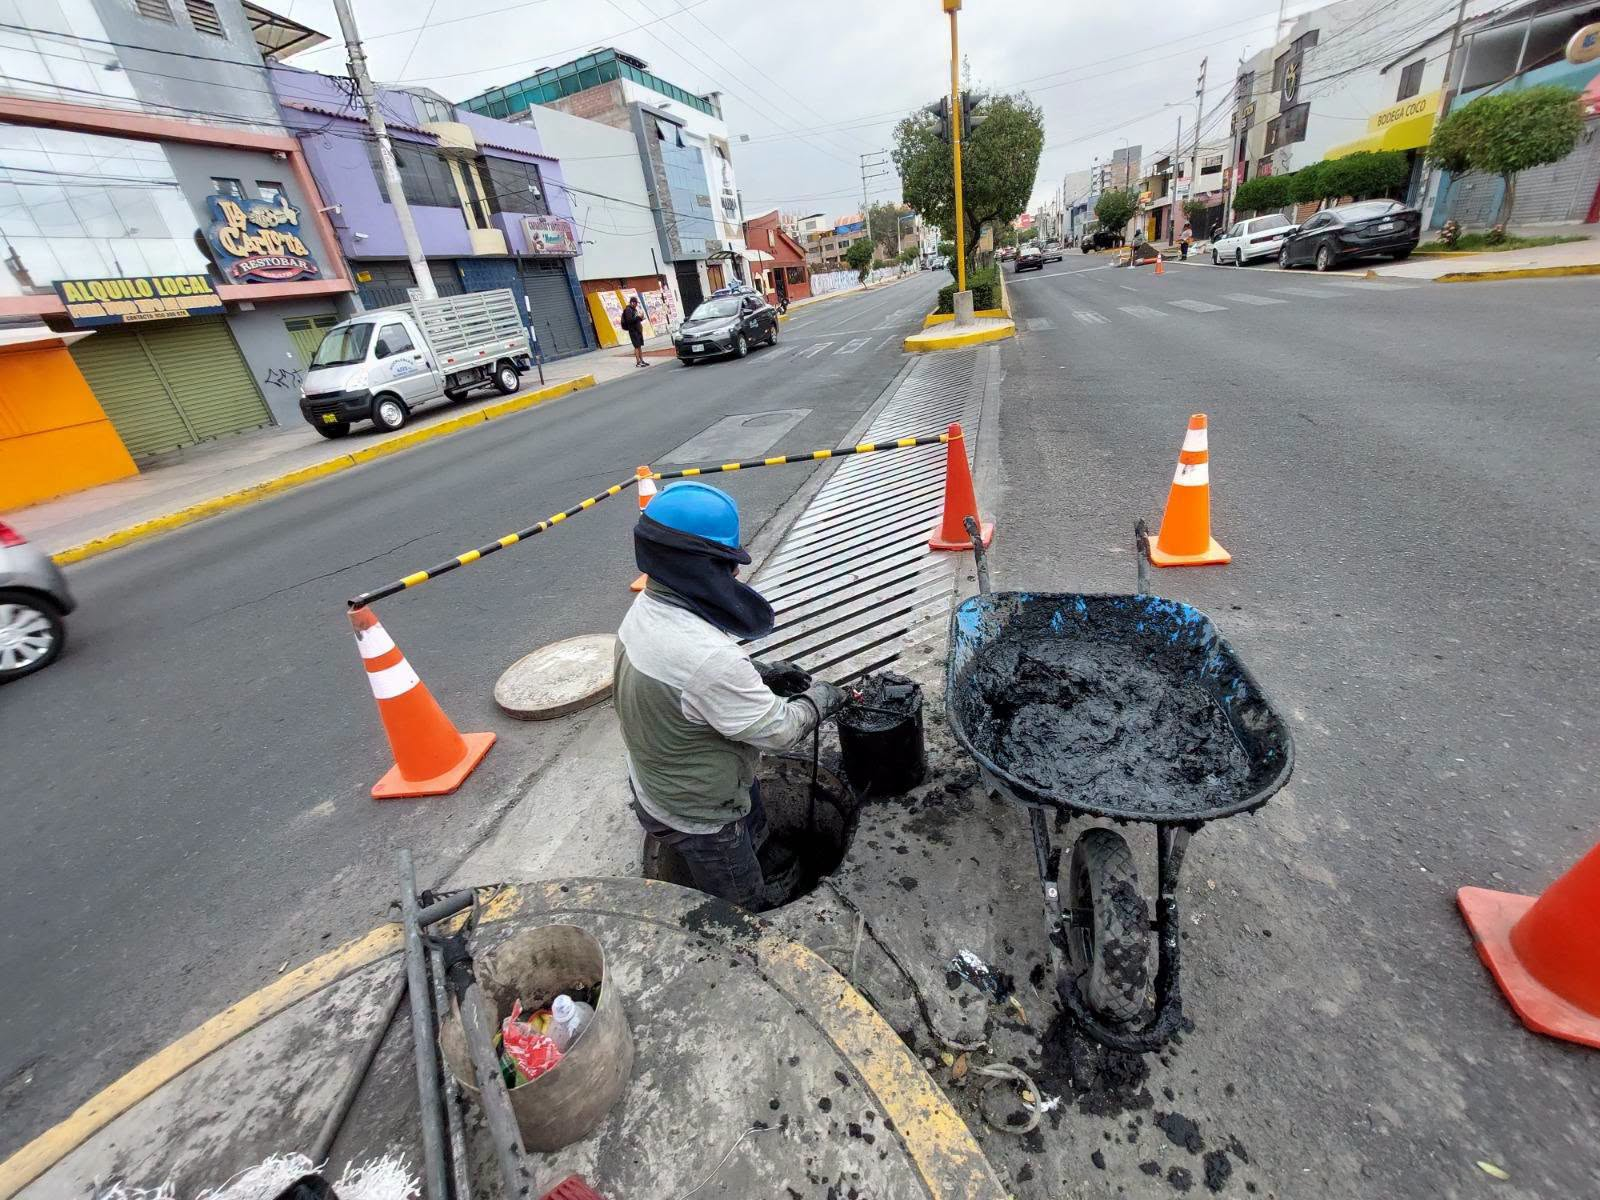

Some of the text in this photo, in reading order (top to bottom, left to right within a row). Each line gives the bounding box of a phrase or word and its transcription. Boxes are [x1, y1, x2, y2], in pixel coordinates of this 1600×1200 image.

[1377, 99, 1426, 127] BODEGA COCO
[240, 257, 308, 272] RESTOBAR
[62, 276, 214, 302] ALQUILO LOCAL
